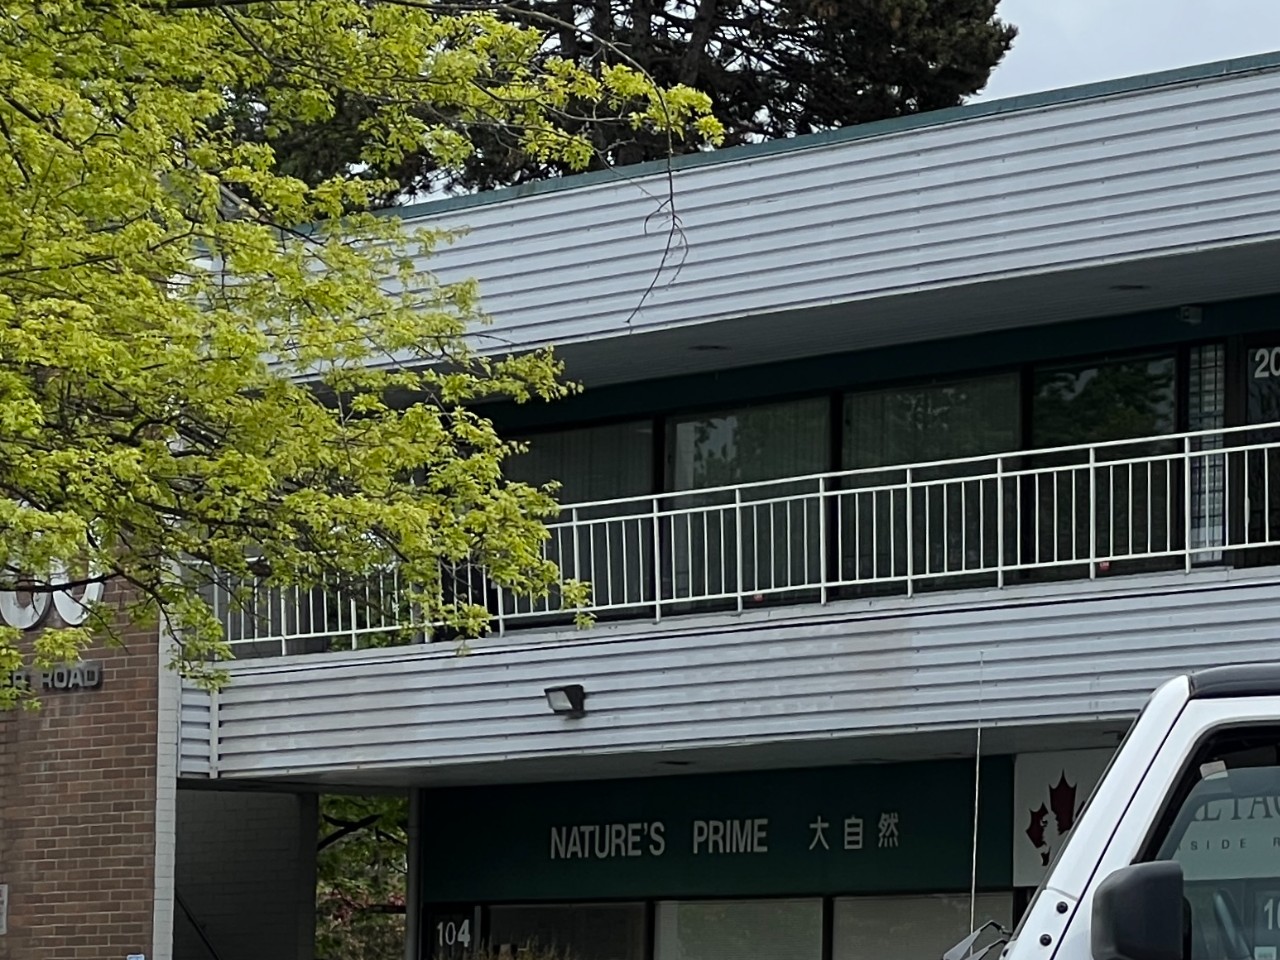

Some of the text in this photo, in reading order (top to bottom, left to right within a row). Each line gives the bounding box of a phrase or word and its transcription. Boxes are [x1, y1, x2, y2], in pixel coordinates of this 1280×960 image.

[41, 664, 99, 689] ROAD
[550, 811, 900, 860] NATURE'S PRIME 大自然
[1177, 838, 1247, 851] SIDE
[436, 919, 471, 948] 104
